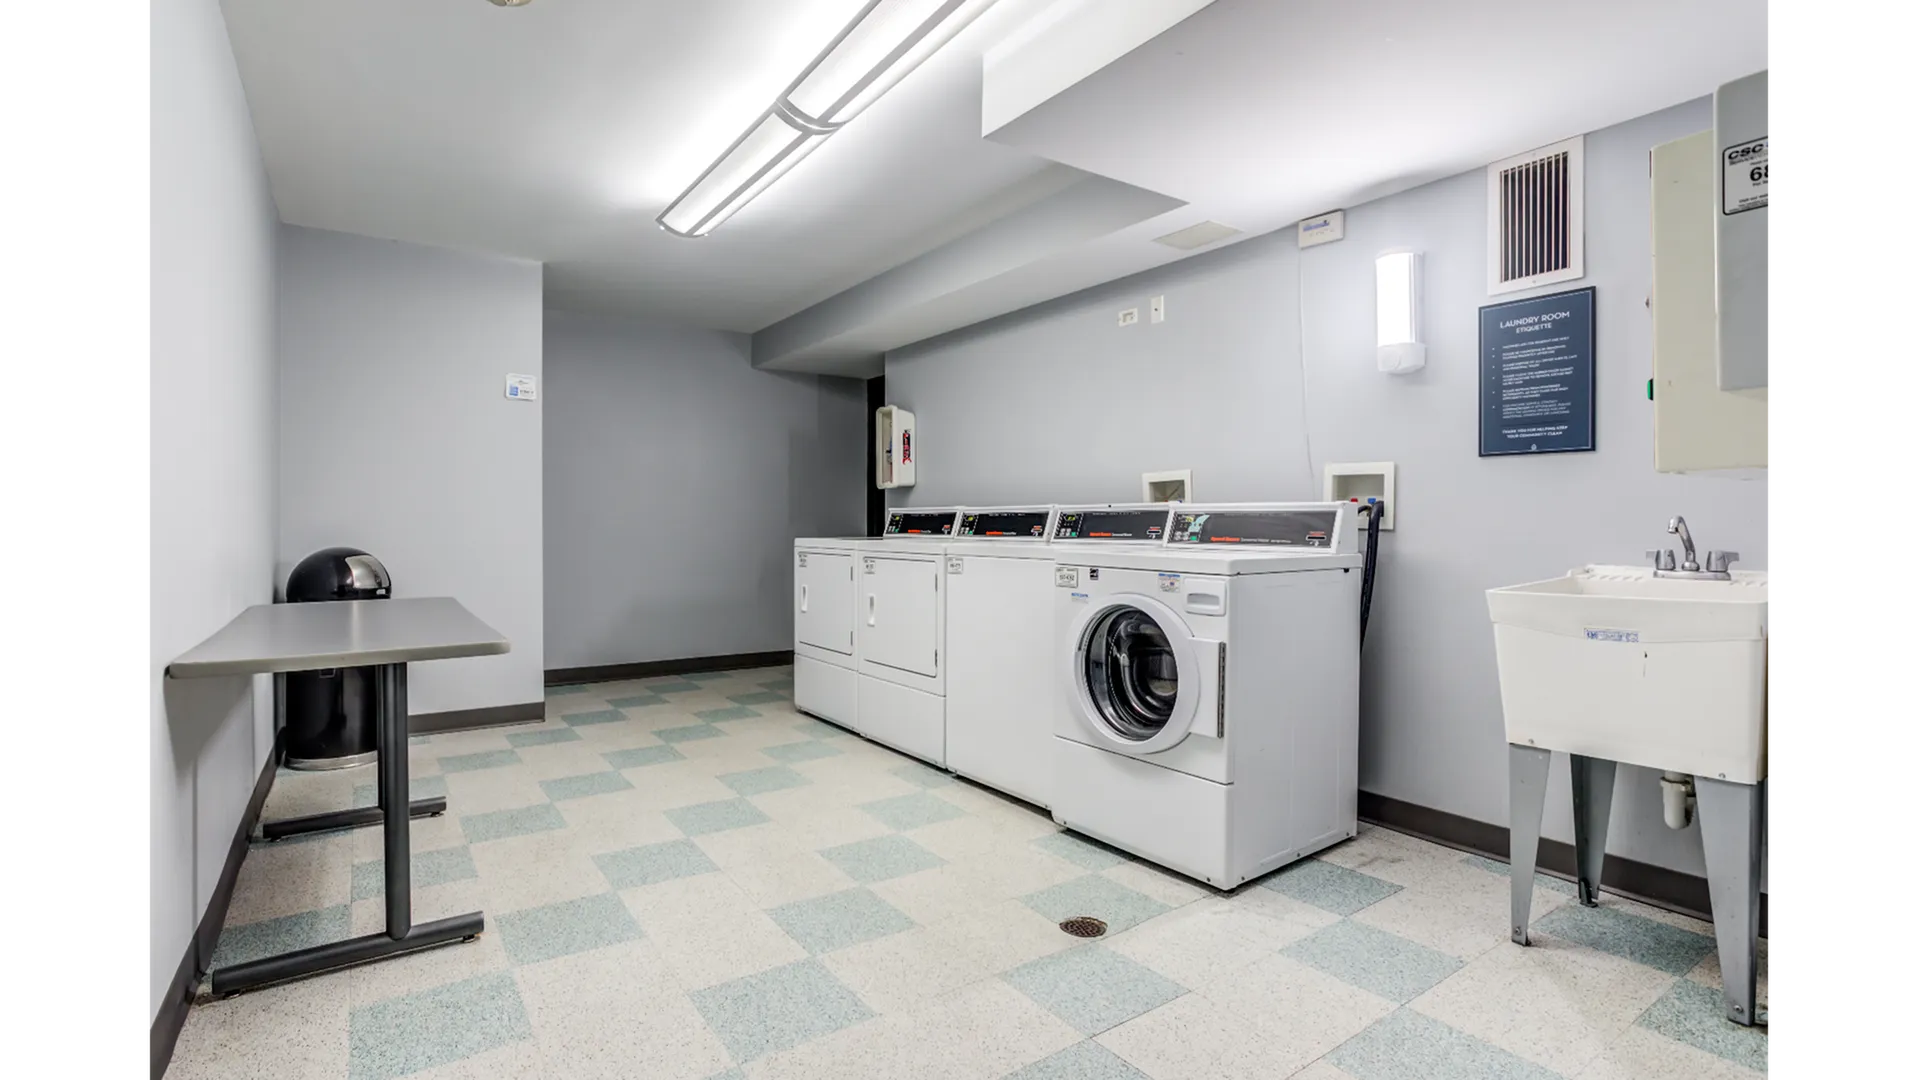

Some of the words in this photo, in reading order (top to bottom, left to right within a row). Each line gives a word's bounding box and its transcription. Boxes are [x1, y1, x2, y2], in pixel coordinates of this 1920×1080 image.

[1728, 143, 1764, 160] CSC
[1500, 315, 1540, 329] LAUNDRY
[1541, 311, 1570, 322] ROOM
[1516, 322, 1552, 334] ETIQUETTE
